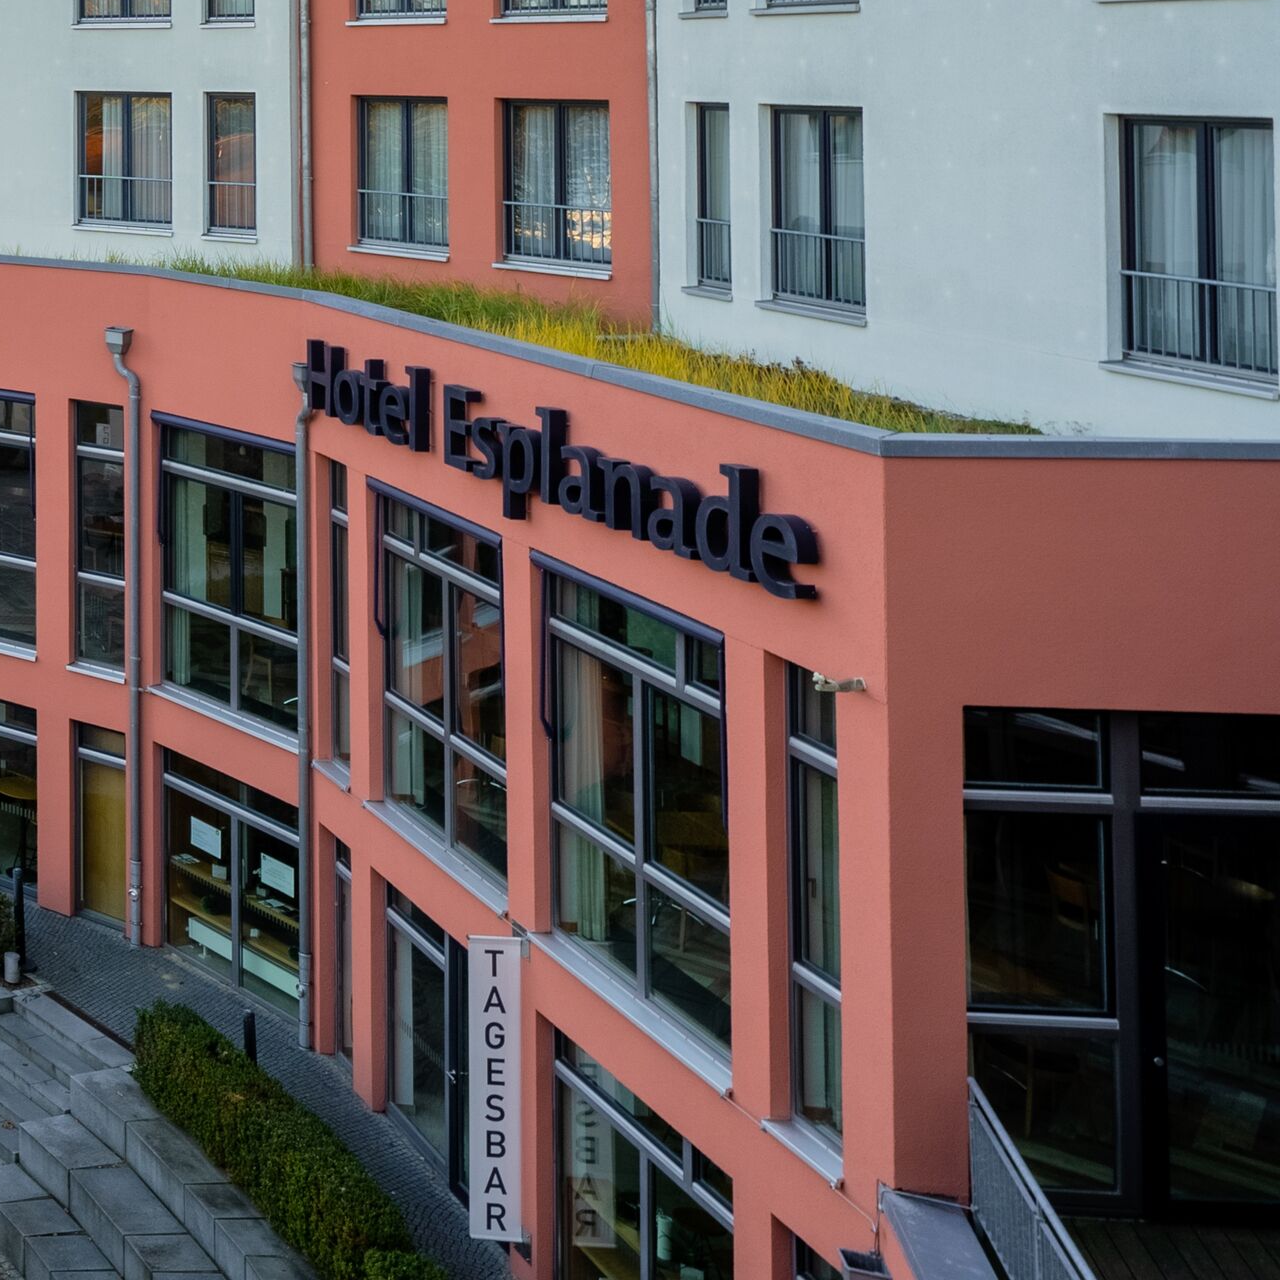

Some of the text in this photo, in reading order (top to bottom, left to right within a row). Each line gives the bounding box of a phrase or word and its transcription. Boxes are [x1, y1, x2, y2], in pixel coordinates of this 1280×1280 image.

[306, 338, 819, 599] Hotel Esplanade
[483, 949, 507, 1232] TAGESBAR
